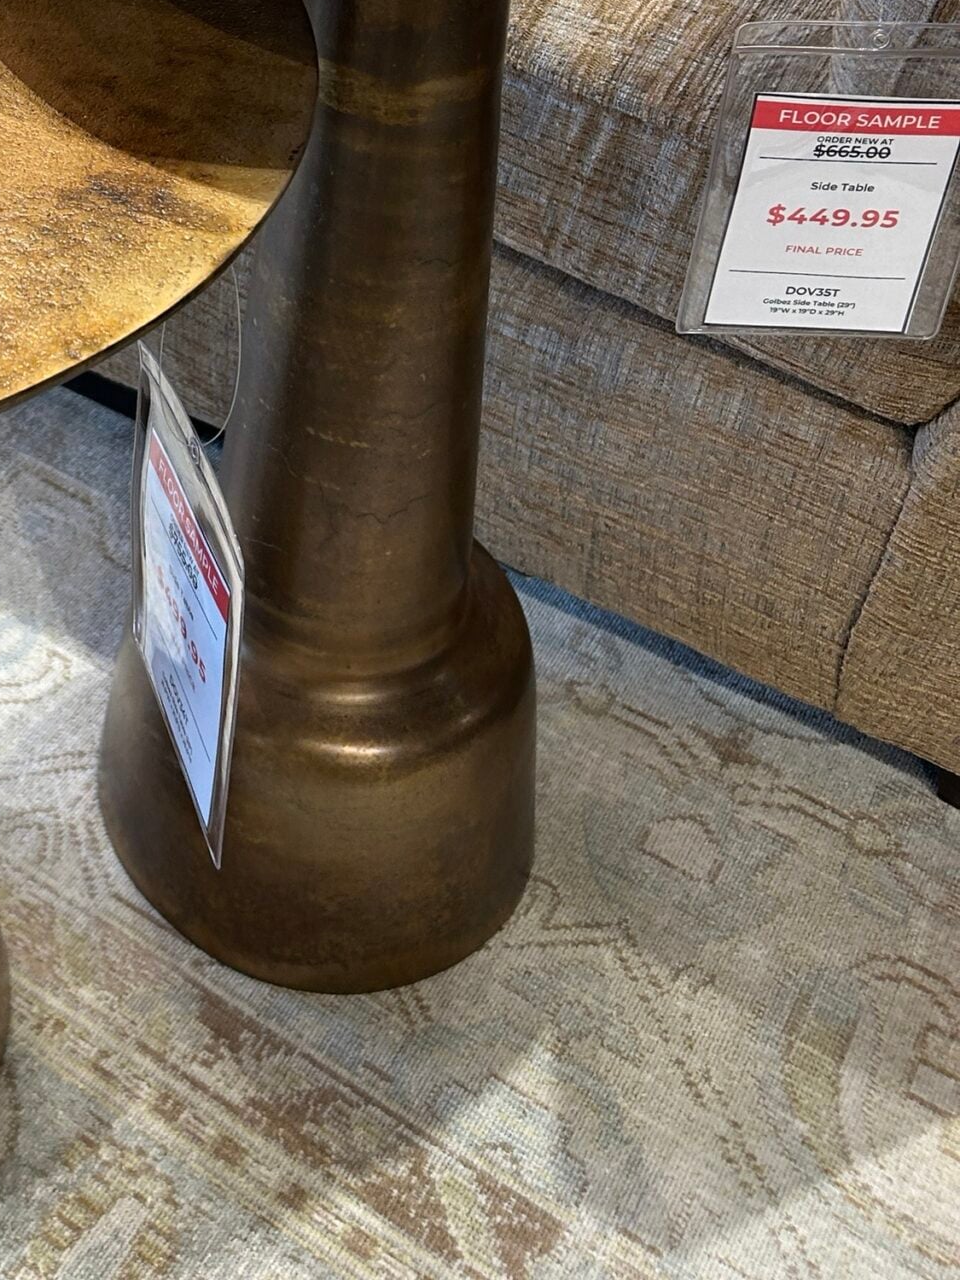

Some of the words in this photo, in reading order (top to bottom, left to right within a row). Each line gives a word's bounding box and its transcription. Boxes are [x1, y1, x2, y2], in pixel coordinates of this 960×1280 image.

[779, 109, 851, 127] FLOOR
[856, 113, 942, 129] SAMPLE
[817, 135, 852, 145] ORDER
[854, 137, 880, 145] NEW
[880, 138, 895, 146] AT
[813, 143, 891, 159] $665.00
[810, 181, 838, 192] Side
[841, 183, 875, 193] Table
[766, 203, 900, 228] $449.95
[785, 244, 822, 255] FINAL
[825, 247, 864, 257] PRICE
[813, 300, 835, 308] Table
[157, 461, 185, 519] FLOOR
[185, 517, 218, 595] SAMPLE
